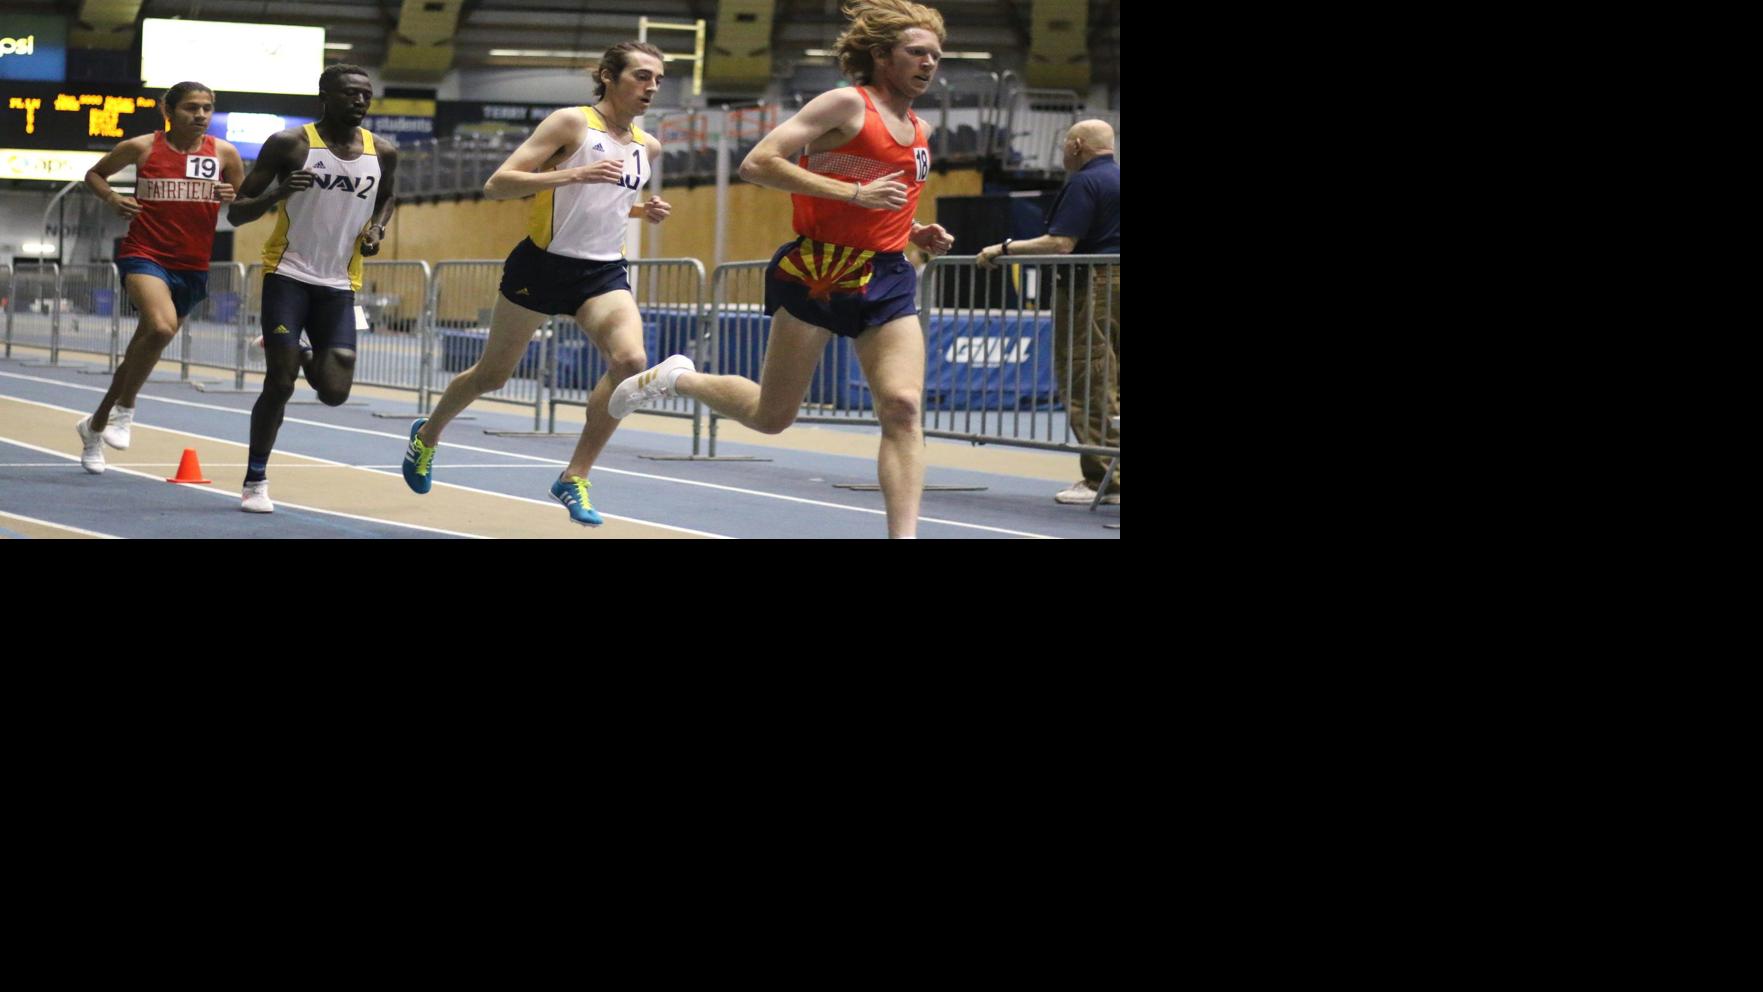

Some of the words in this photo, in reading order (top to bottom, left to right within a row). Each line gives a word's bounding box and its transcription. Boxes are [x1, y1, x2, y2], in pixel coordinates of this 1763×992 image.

[190, 157, 217, 178] 19
[632, 149, 641, 175] 1
[916, 149, 928, 180] 18
[356, 175, 376, 200] 2
